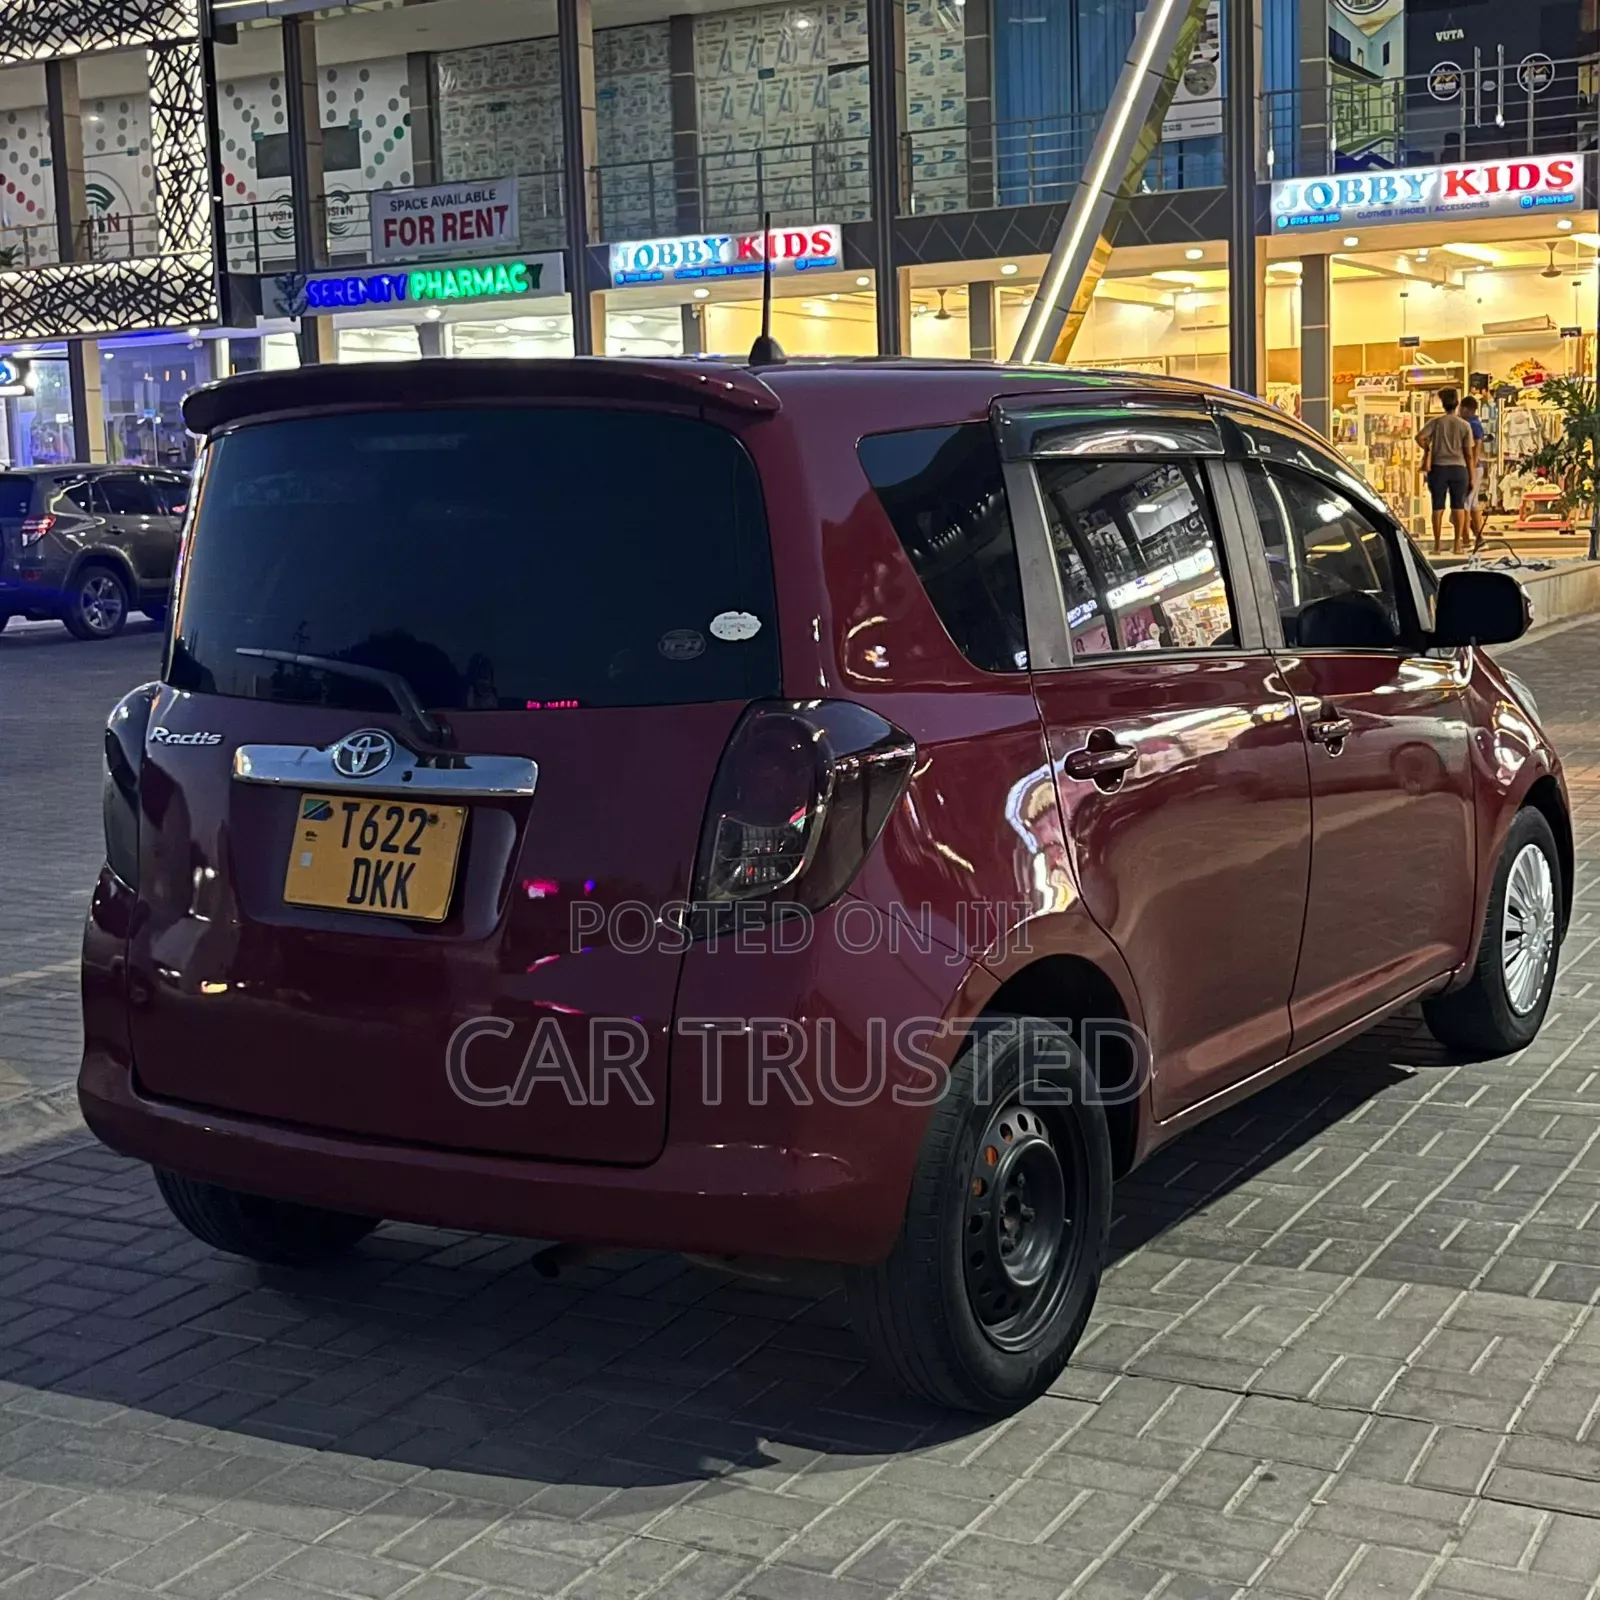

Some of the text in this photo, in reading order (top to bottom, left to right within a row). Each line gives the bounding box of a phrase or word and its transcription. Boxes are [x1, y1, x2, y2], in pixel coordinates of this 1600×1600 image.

[1435, 29, 1464, 41] VUTA
[389, 188, 497, 212] SPACE AVAILABLE
[1275, 160, 1574, 211] JOBBY KIDS
[383, 205, 509, 248] FOR RENT
[1357, 200, 1490, 219] CLOTHES SHOES ACCESSORIES
[613, 237, 730, 272] JOBBY
[736, 230, 833, 260] KIDS
[305, 260, 544, 308] SERENITY PHARMACY
[148, 726, 222, 745] Ractis
[341, 802, 428, 856] T622
[346, 857, 416, 910] DKK
